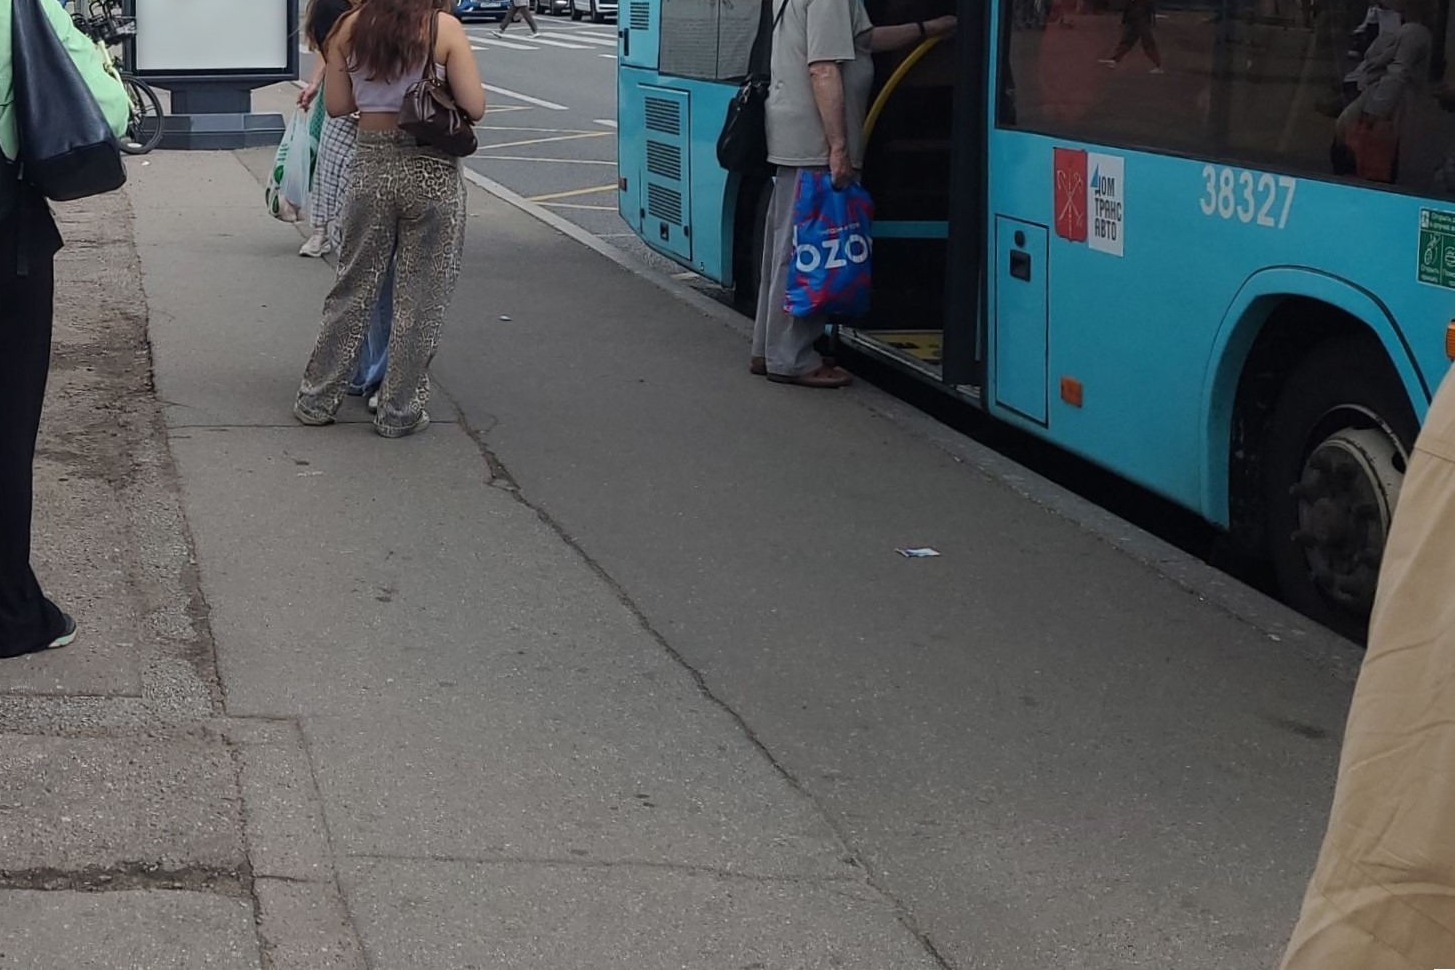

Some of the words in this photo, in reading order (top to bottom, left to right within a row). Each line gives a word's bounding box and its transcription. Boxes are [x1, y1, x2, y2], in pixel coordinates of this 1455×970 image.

[1199, 165, 1296, 229] 38327
[1094, 198, 1122, 222] ТРАНС
[1094, 218, 1117, 241] АВТО
